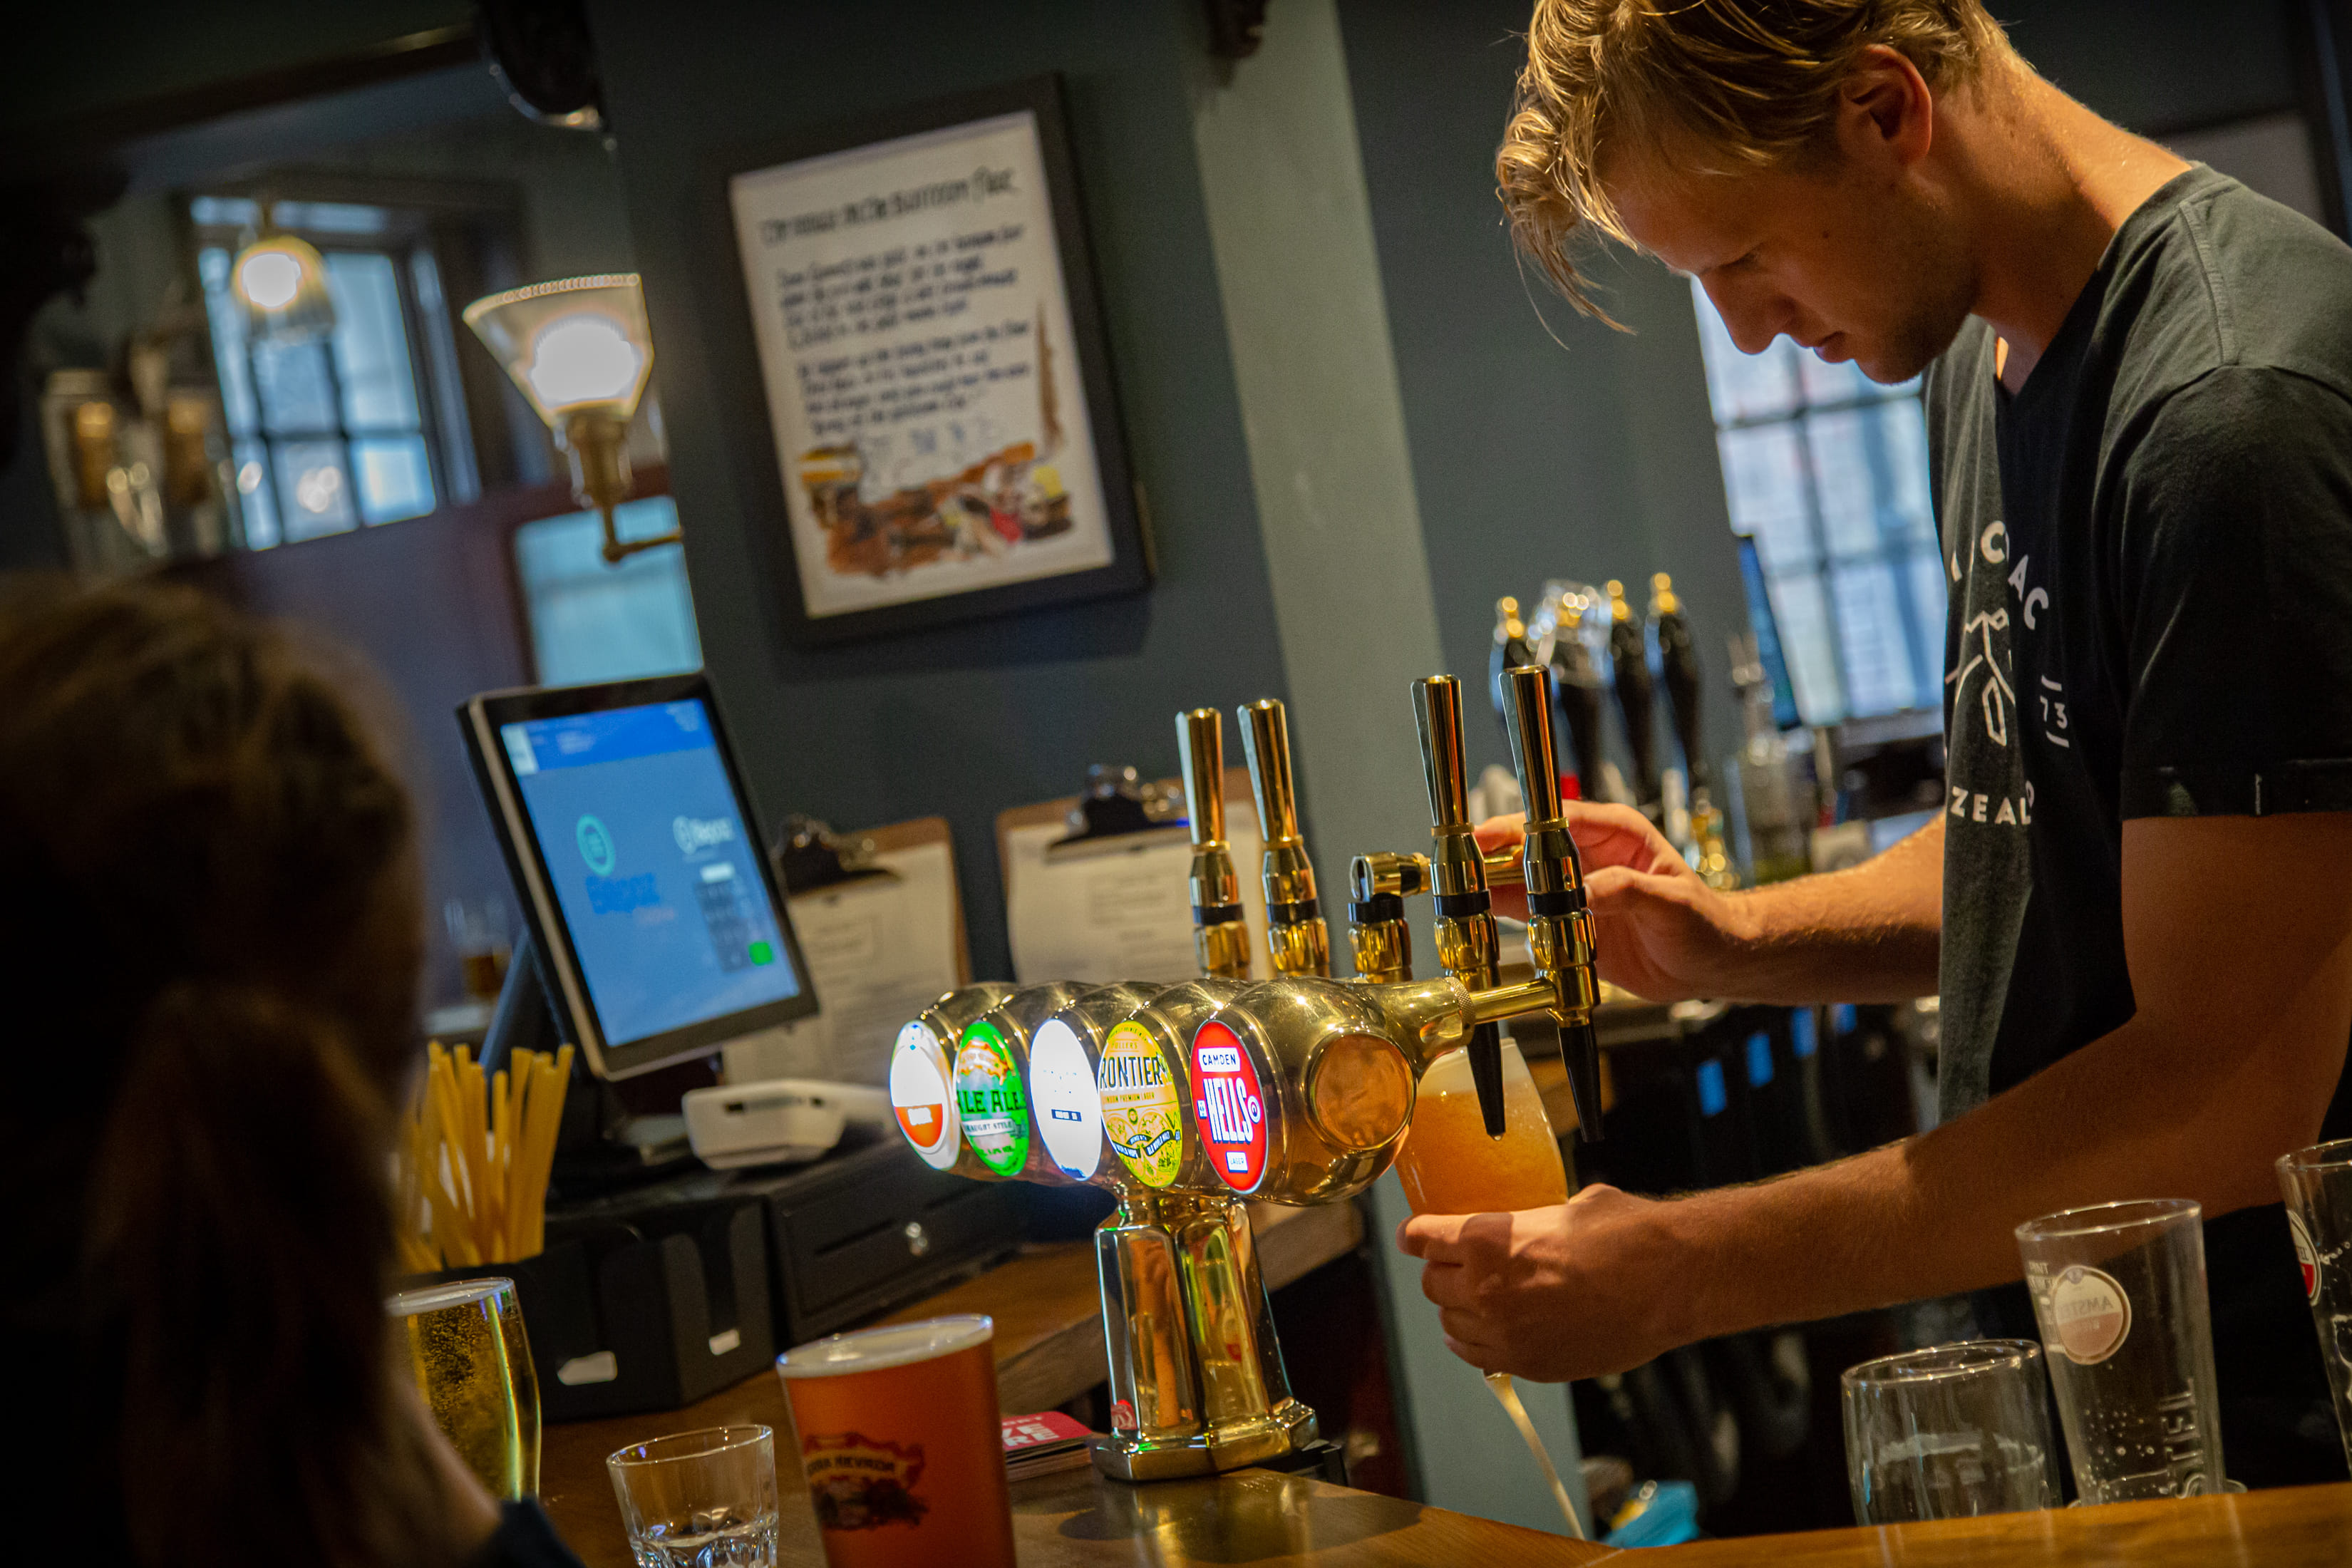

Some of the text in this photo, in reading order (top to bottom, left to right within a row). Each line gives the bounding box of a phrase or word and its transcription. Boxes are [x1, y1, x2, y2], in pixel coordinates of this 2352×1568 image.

[1202, 1054, 1237, 1066] CAMDEN
[1100, 1056, 1164, 1089] RONTIER
[956, 1090, 987, 1113] ALE
[1203, 1077, 1254, 1145] HELLS
[964, 1123, 991, 1133] RAUGHT
